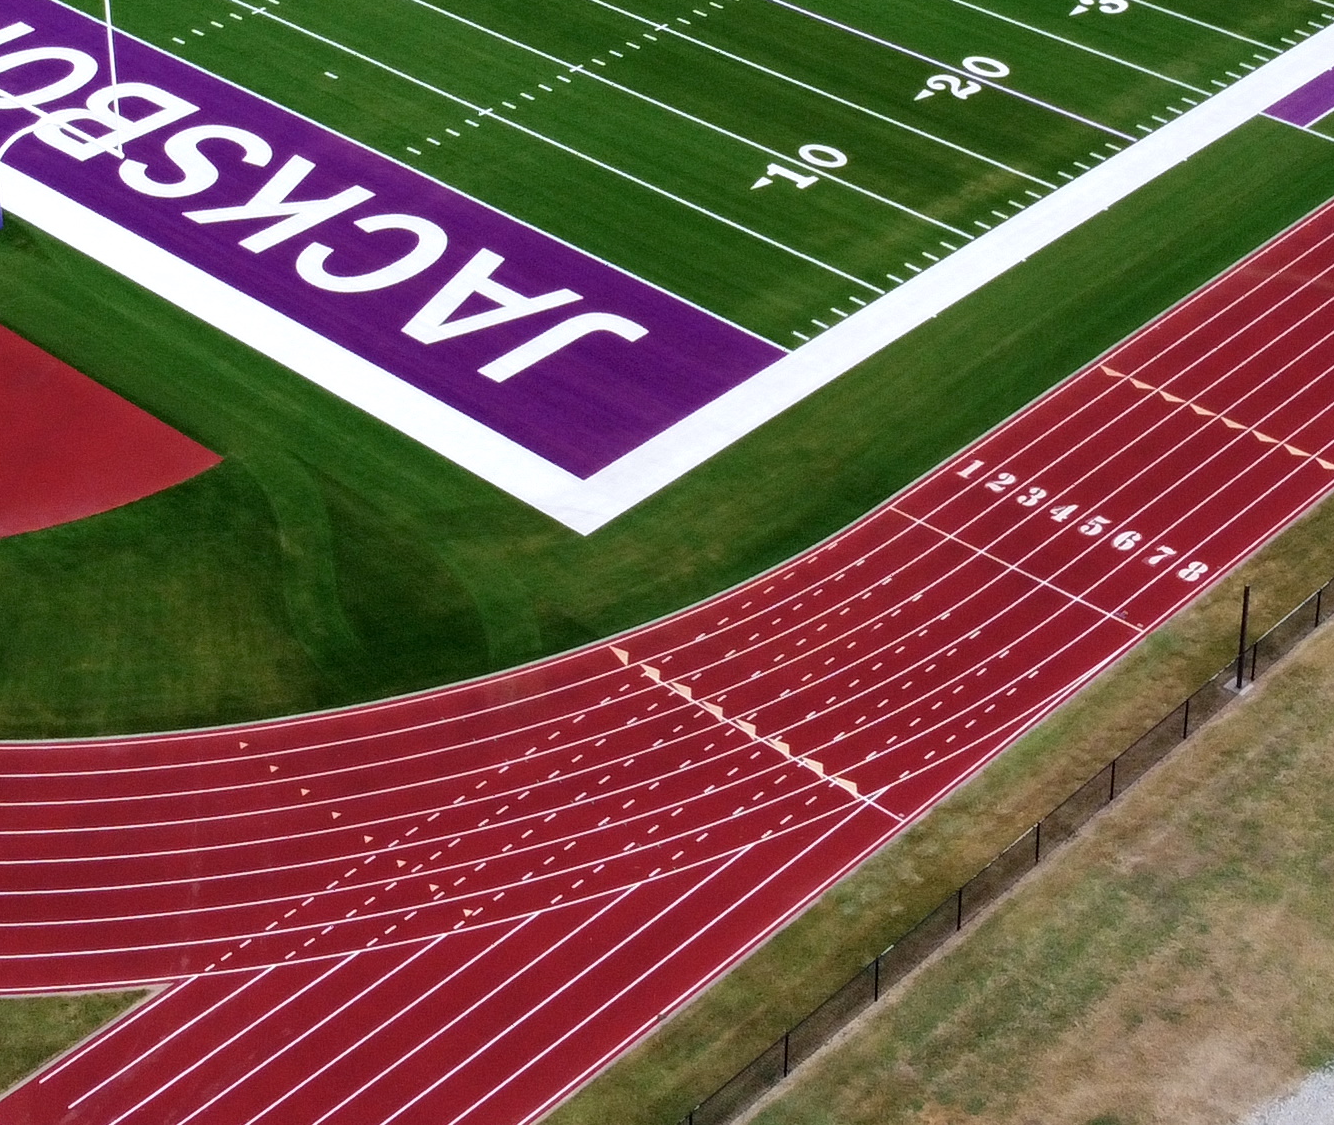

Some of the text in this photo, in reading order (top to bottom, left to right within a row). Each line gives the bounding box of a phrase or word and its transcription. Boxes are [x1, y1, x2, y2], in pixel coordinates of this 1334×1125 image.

[927, 56, 1010, 99] 20
[767, 144, 848, 189] 10
[957, 459, 1208, 581] 1 2 3 4 5 6 7 8
